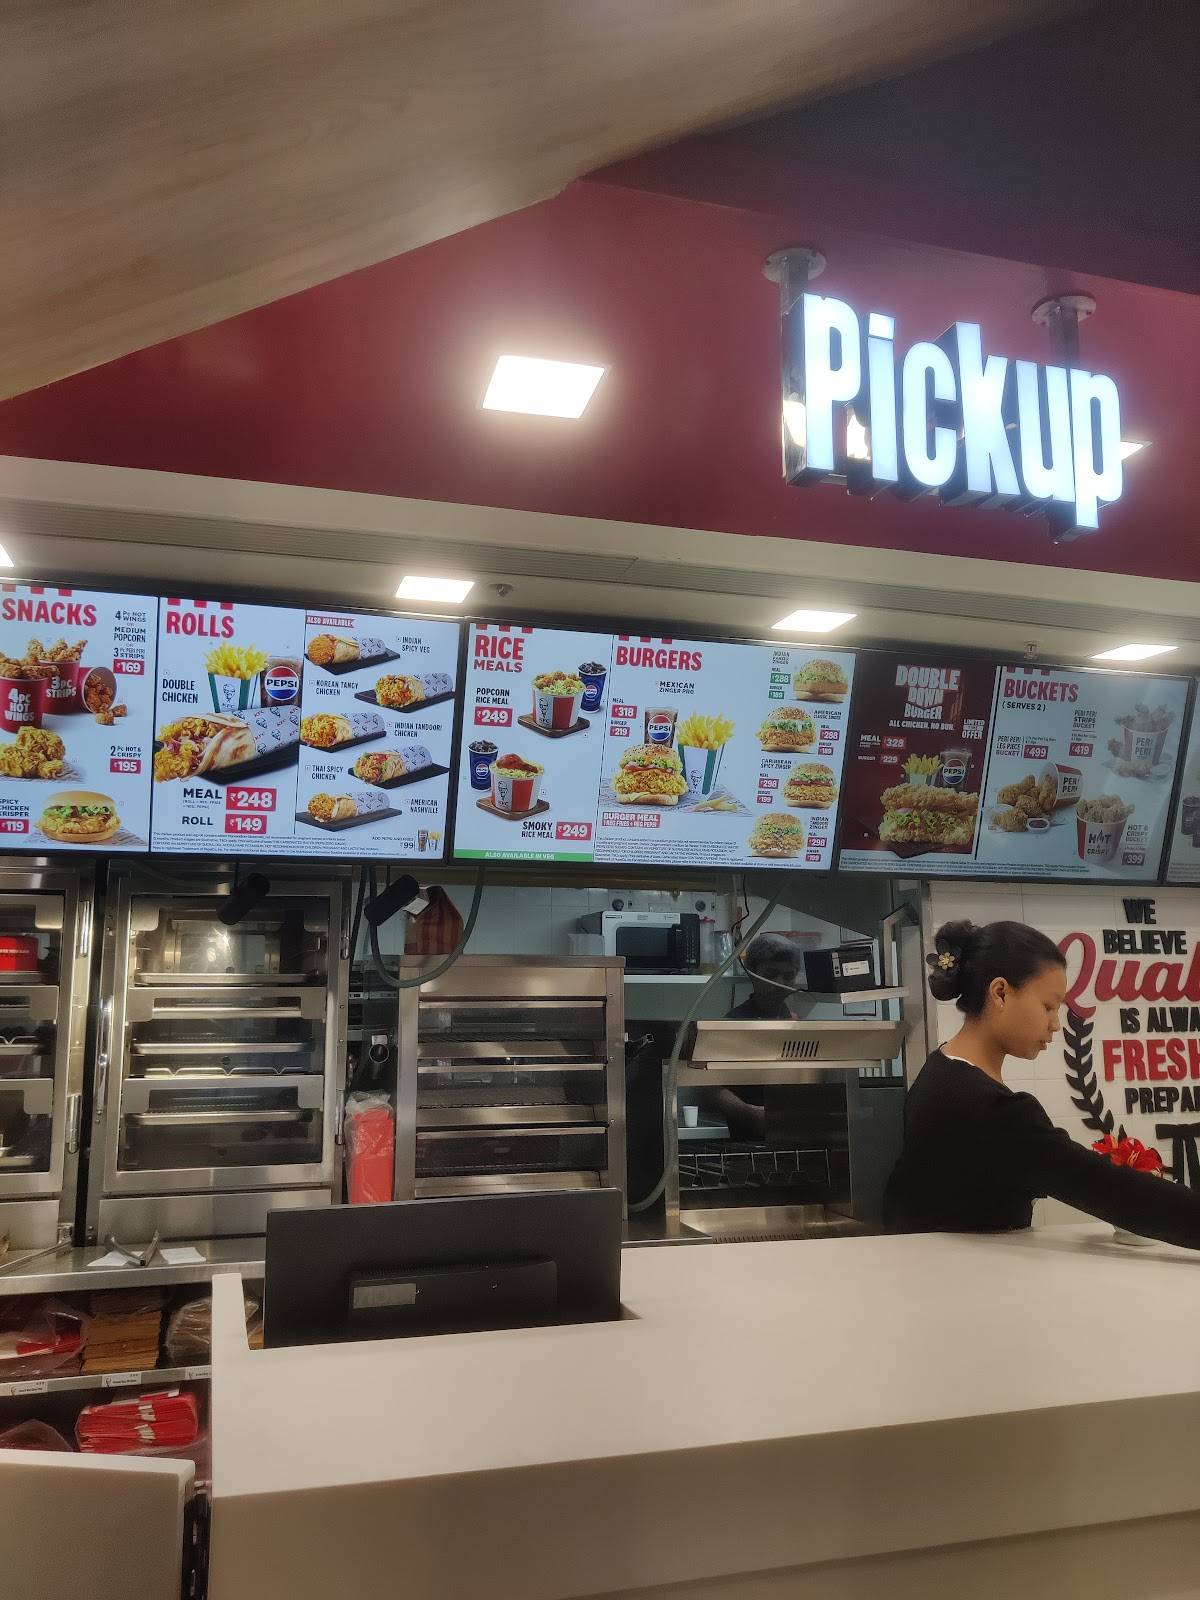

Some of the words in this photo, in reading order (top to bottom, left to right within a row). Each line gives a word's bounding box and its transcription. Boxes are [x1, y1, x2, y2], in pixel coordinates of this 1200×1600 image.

[803, 293, 1122, 529] Pickup
[2, 598, 97, 627] SNACKS
[166, 611, 235, 638] ROLLS
[307, 616, 322, 624] ALSO
[323, 618, 352, 627] AVAILABLE
[113, 633, 146, 643] POPCORN
[403, 637, 422, 645] INDIAN
[402, 645, 417, 653] SPICY
[475, 634, 525, 660] RICE
[616, 646, 703, 672] BURGERS
[473, 659, 523, 673] MEALS
[895, 665, 961, 691] DOUBLE
[162, 679, 195, 691] DOUBLE
[266, 680, 298, 689] PEPSI
[316, 680, 340, 688] KOREAN
[659, 681, 695, 689] MEXICAN
[46, 687, 77, 698] STRIPS
[315, 688, 341, 697] CHICKEN
[476, 687, 510, 697] POPCORN
[1004, 678, 1079, 703] BUCKETS
[162, 692, 199, 704] CHICKEN
[475, 696, 491, 704] RICE
[491, 697, 508, 705] MEAL
[907, 687, 944, 708] DOWN
[10, 702, 30, 713] HOT
[903, 702, 943, 720] BURGER
[4, 710, 35, 721] WINGS
[476, 709, 509, 724] ₹249
[1073, 716, 1096, 724] STRIPS
[394, 722, 413, 730] INDIAN
[649, 724, 671, 732] PEPSI
[889, 719, 900, 727] ALL
[394, 729, 418, 738] CHICKEN
[860, 734, 881, 743] MEAL
[961, 730, 983, 740] OFFER
[312, 764, 327, 773] THAI
[327, 766, 344, 774] SPICY
[943, 767, 964, 775] PEPSI
[311, 773, 336, 781] CHICKEN
[183, 788, 222, 799] MEAL
[230, 791, 273, 808] ₹248
[410, 806, 438, 814] NASHVILLE
[182, 816, 214, 826] ROLL
[603, 812, 635, 821] BURGER
[637, 814, 659, 822] MEAL
[229, 818, 263, 832] ₹149
[522, 821, 553, 831] SMOKY
[521, 830, 537, 838] RICE
[537, 831, 554, 840] MEAL
[558, 824, 588, 837] ₹249
[1123, 899, 1156, 924] WE
[1102, 929, 1187, 955] BELIEVE
[1119, 1007, 1140, 1033] IS
